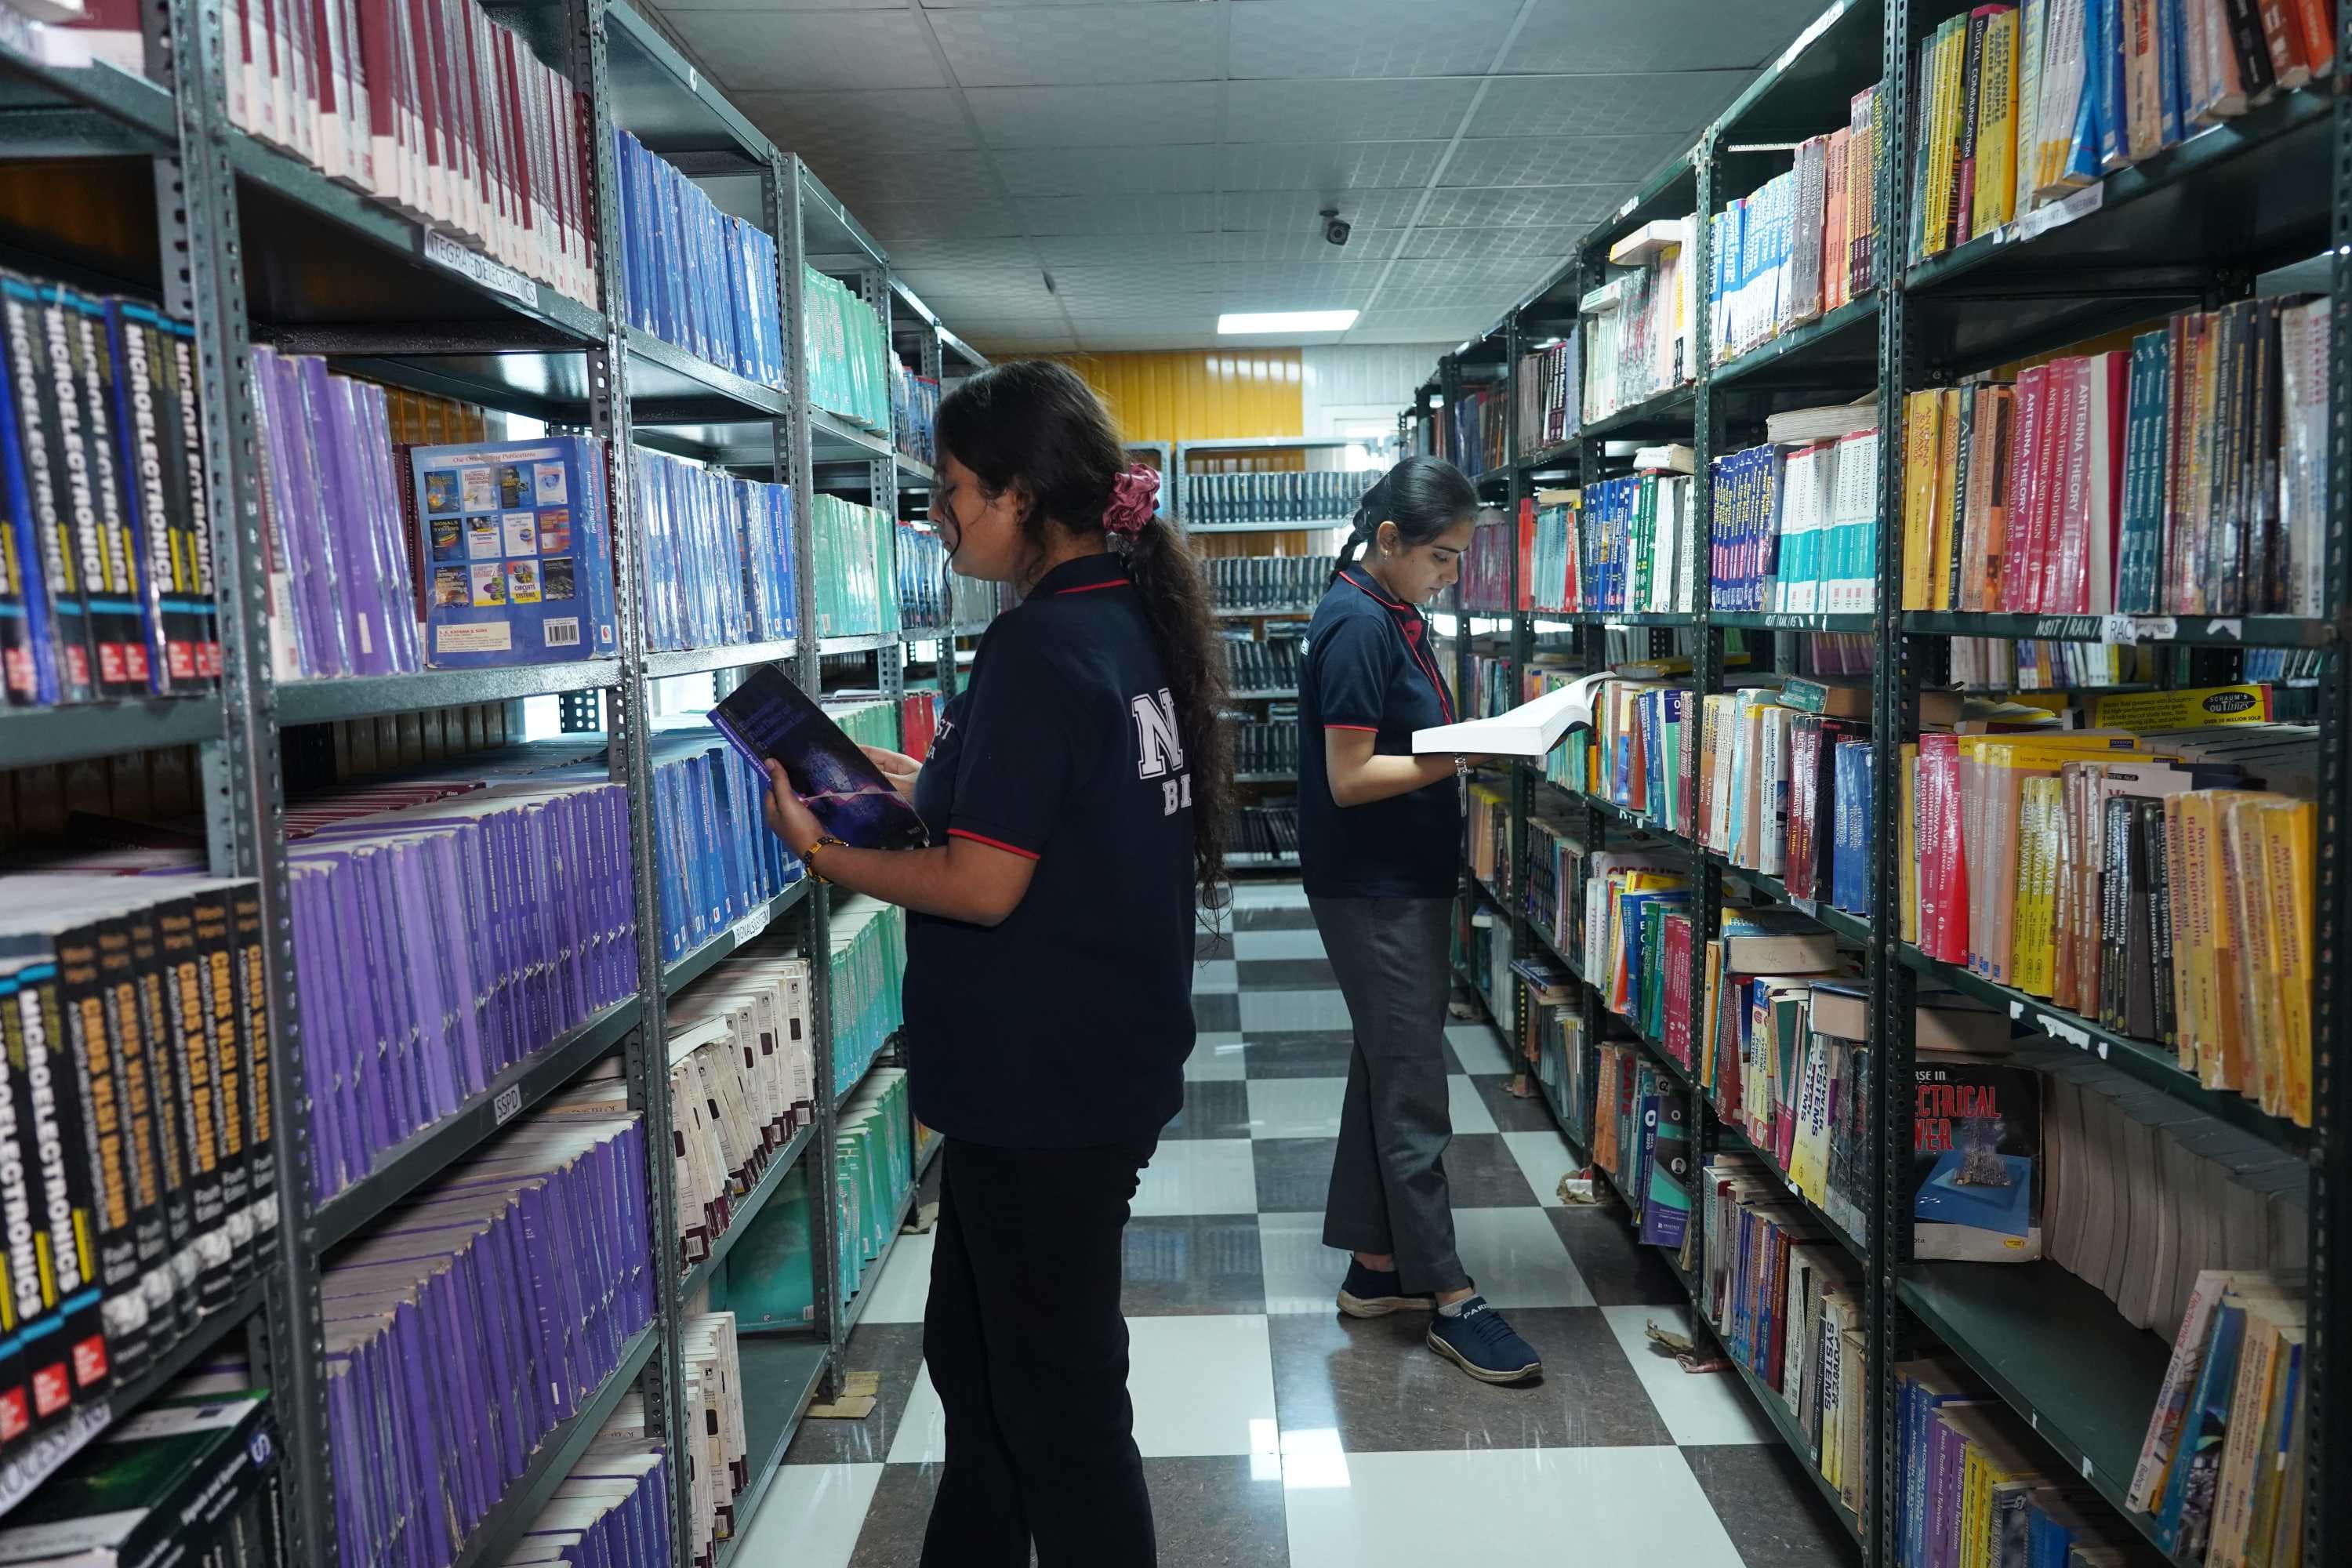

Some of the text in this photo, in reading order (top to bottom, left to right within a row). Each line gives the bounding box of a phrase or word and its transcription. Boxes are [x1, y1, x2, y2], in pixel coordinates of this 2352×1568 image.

[1963, 20, 1984, 158] DIGITAL COMMUNICATION
[1985, 78, 1994, 129] SIMPLE
[2001, 26, 2010, 119] ELECTRONICS
[6, 300, 66, 593] MICROELECTRONICS
[44, 308, 105, 593] MICROELECTRONICS
[125, 323, 174, 593] MICROELECTRONICS
[1955, 421, 1969, 522] Antennas
[2019, 393, 2035, 514] ANTENNA THEORY
[2034, 388, 2056, 539] ANTENNA THEORY AND DESIGN
[2049, 388, 2070, 542] ANTENNA THEORY AND DESIGN
[2069, 385, 2089, 512] ANTENNA THEORY
[2111, 620, 2134, 641] RAC
[1639, 697, 1648, 729] ELECTRICAL
[2209, 693, 2249, 703] SCHAUM'S
[1793, 732, 1805, 818] ELECTRICAL ANALYSIS
[1806, 735, 1816, 768] ELECTRICAL
[1803, 793, 1814, 820] ANALYSIS
[1926, 776, 1935, 855] ENGINEERING
[1932, 776, 1942, 848] MICROWAVE
[2020, 804, 2034, 891] MICROWAVES
[2044, 805, 2062, 895] MICROWAVES
[1938, 830, 1951, 891] Engineering
[2033, 806, 2045, 896] MICROWAVES
[2109, 806, 2122, 938] Microwave Engineering
[2169, 815, 2183, 942] Radar Engineering
[2187, 816, 2203, 948] Radar Engineering
[2198, 827, 2210, 935] Microwave and
[2281, 847, 2297, 931] Microwave
[2102, 873, 2111, 941] Engineering
[2119, 877, 2129, 945] Engineering
[2150, 893, 2159, 964] Engineering
[2161, 887, 2171, 959] Engineering
[2220, 829, 2239, 963] Radar Engineering
[2245, 880, 2262, 972] Engineering
[2271, 835, 2292, 978] Radar Engineering
[82, 997, 110, 1075] CMOS
[178, 962, 216, 1173] CMOS VLSI Design
[210, 950, 241, 1155] CMOS VLSI Design
[248, 944, 272, 1142] CMOS VLSI Design
[1934, 1070, 1946, 1081] IN
[92, 1076, 118, 1134] VLSI
[117, 983, 156, 1206] CMOS VLSI Design
[497, 1090, 518, 1119] SSPD
[1800, 1039, 1816, 1123] SYSTEMS
[1812, 1049, 1824, 1137] SYSTEMS
[1819, 1064, 1828, 1131] POWER
[18, 989, 81, 1293] MICROELECTRONICS
[100, 1134, 129, 1229] Design
[2176, 1291, 2201, 1348] Electronics
[1824, 1321, 1835, 1411] SYSTEMS
[1938, 1452, 1947, 1476] Radio
[1939, 1429, 1947, 1450] Basic
[1957, 1465, 1965, 1490] Radio
[1935, 1496, 1944, 1536] Television
[1952, 1511, 1962, 1550] Television
